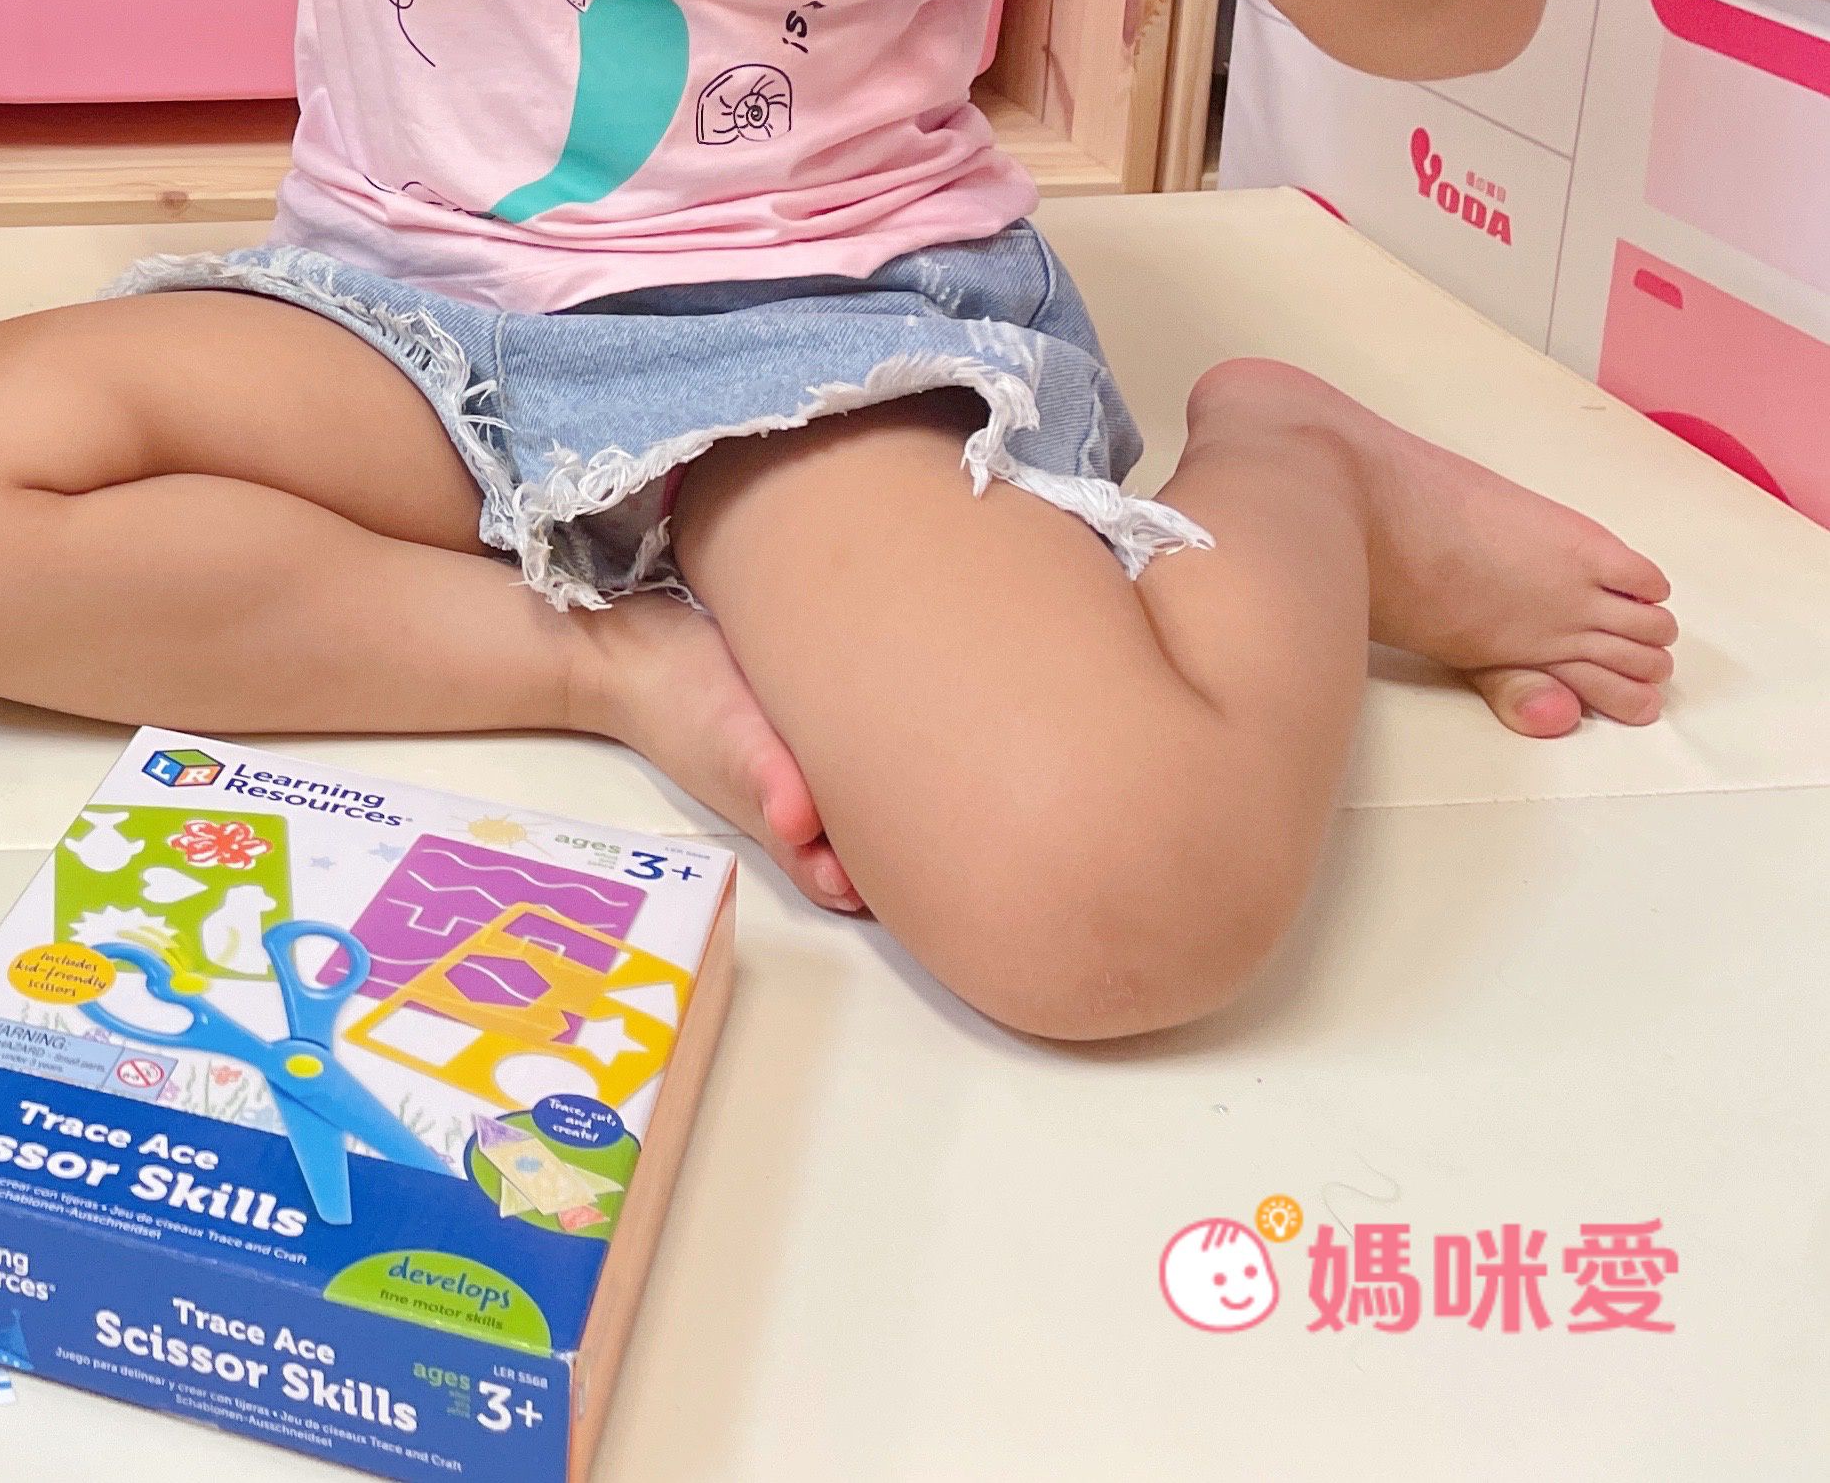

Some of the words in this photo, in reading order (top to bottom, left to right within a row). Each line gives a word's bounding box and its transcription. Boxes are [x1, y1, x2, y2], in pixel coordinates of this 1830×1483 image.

[232, 763, 386, 808] Learning
[554, 834, 622, 855] ages
[623, 850, 703, 881] 3+
[15, 959, 107, 990] kid-friendly
[19, 1099, 132, 1150] Trace
[138, 1133, 220, 1171] Ace
[565, 1117, 592, 1129] and
[33, 1187, 58, 1199] con
[109, 1204, 134, 1220] Jeu
[136, 1212, 154, 1225] de
[155, 1218, 205, 1238] ciseaux
[208, 1229, 243, 1248] Trace
[244, 1240, 272, 1255] and
[273, 1246, 308, 1265] Craft
[130, 1164, 309, 1239] Skills
[380, 1288, 410, 1305] fine
[412, 1297, 462, 1318] motor
[465, 1311, 504, 1331] skills
[388, 1255, 511, 1312] develops
[172, 1297, 266, 1346] Trace
[273, 1325, 336, 1366] Ace
[95, 1309, 269, 1389] Scissor
[281, 1362, 419, 1433] Skills
[413, 1362, 471, 1391] ages
[492, 1364, 515, 1381] LER
[55, 1347, 91, 1366] Juego
[93, 1357, 118, 1374] para
[120, 1365, 166, 1387] delinear
[177, 1382, 208, 1398] crear
[210, 1391, 233, 1406] con
[234, 1395, 270, 1417] tijeras
[280, 1409, 302, 1427] Jeu
[304, 1415, 320, 1431] de
[322, 1422, 367, 1446] ciseaux
[370, 1435, 404, 1457] Trace
[405, 1446, 430, 1463] and
[430, 1452, 462, 1473] Craft
[475, 1379, 544, 1432] 3+
